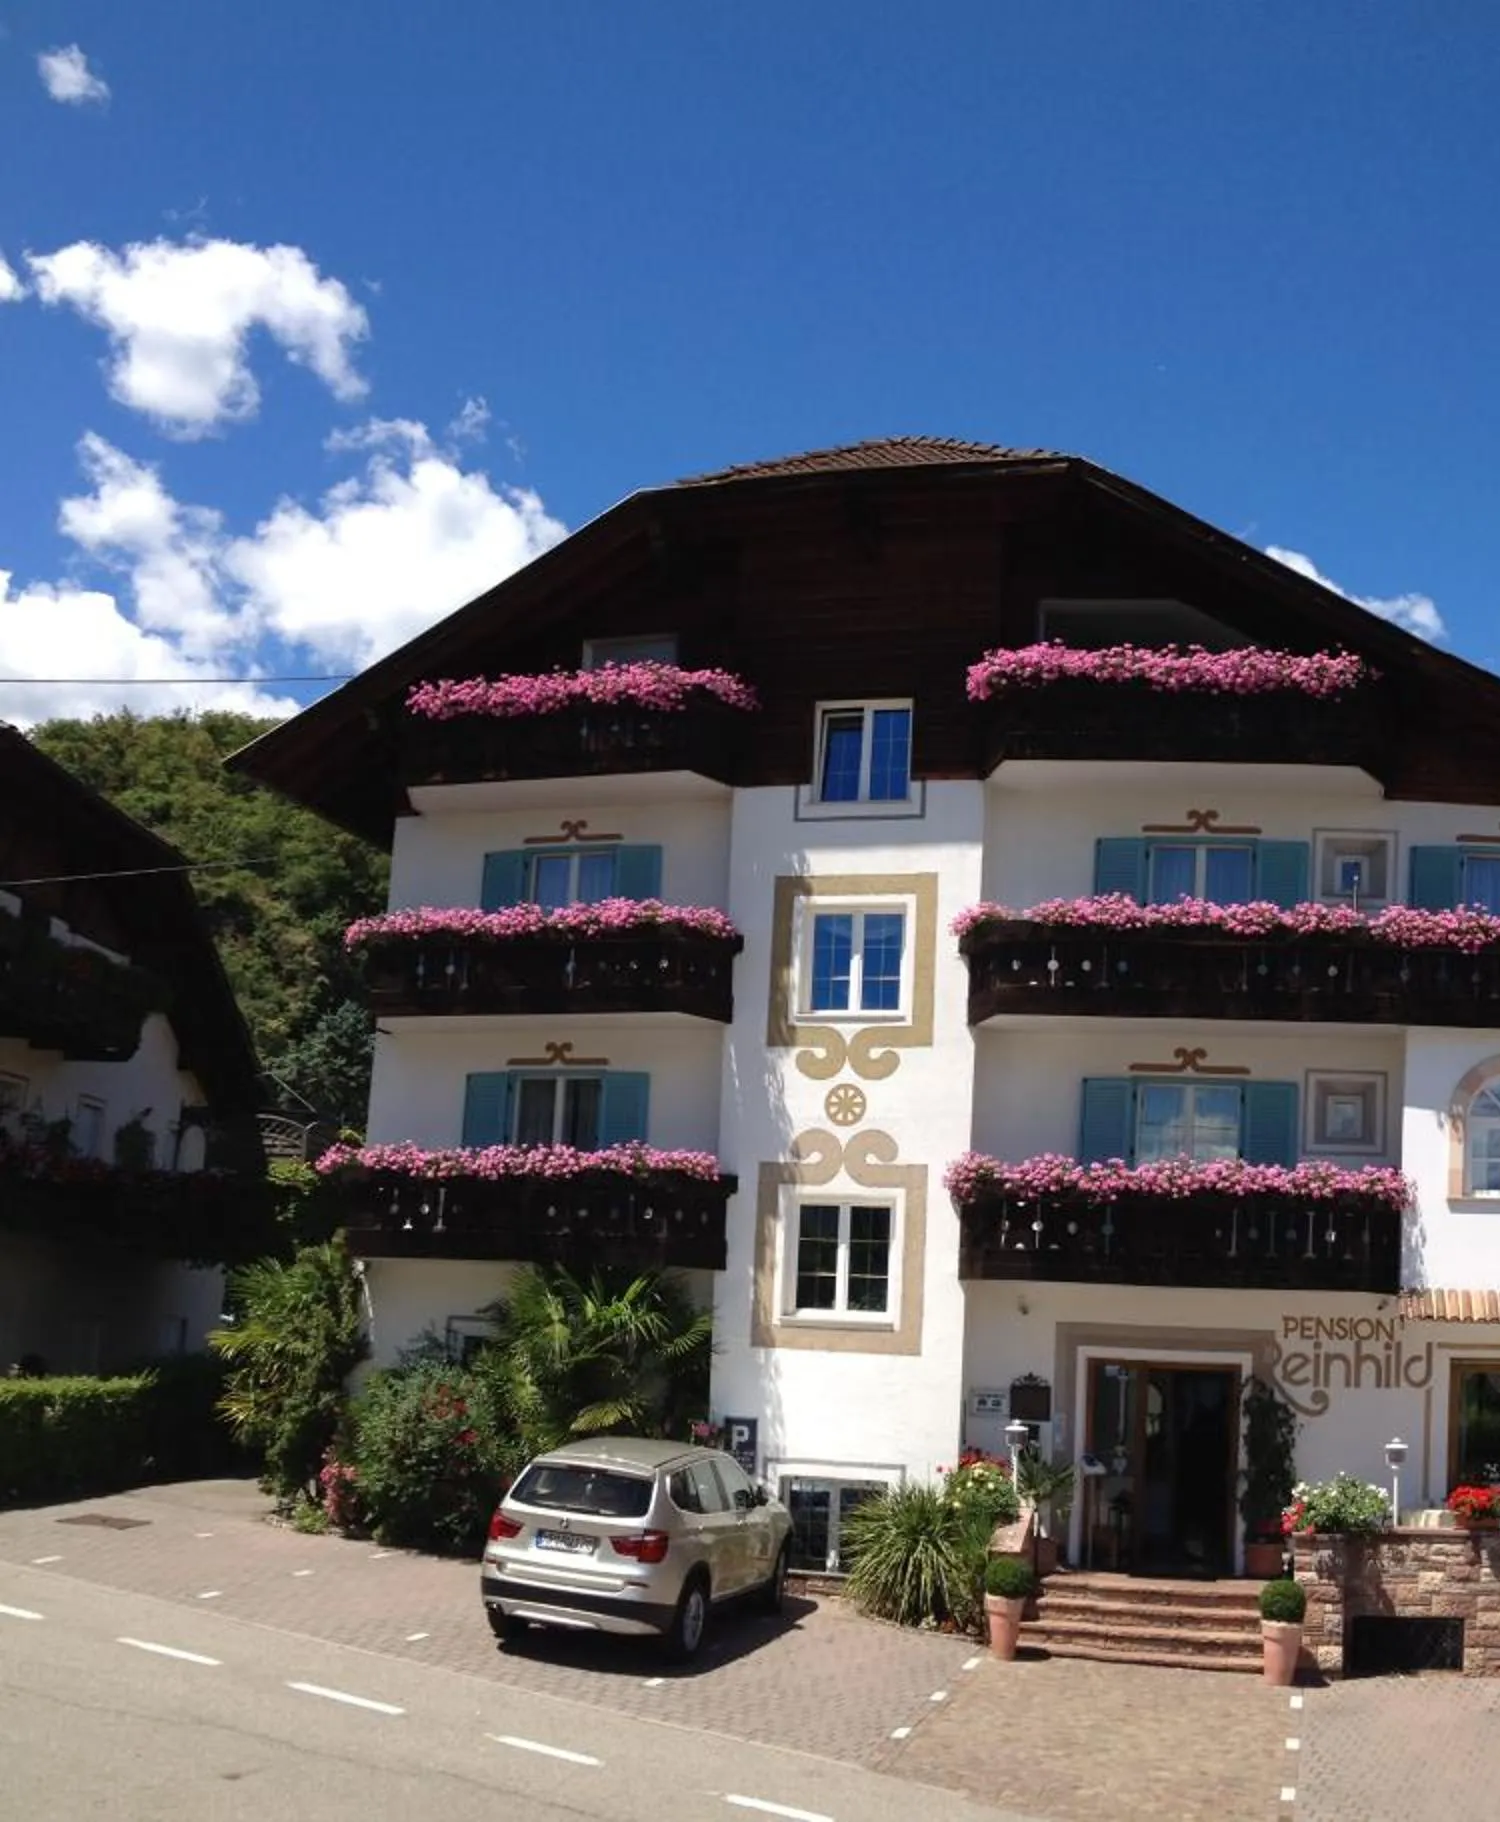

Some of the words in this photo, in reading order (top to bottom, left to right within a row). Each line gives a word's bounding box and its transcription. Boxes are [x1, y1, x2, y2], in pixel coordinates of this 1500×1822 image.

[1282, 1314, 1395, 1342] PENSION
[1256, 1338, 1434, 1417] Reinhild
[731, 1424, 750, 1451] P
